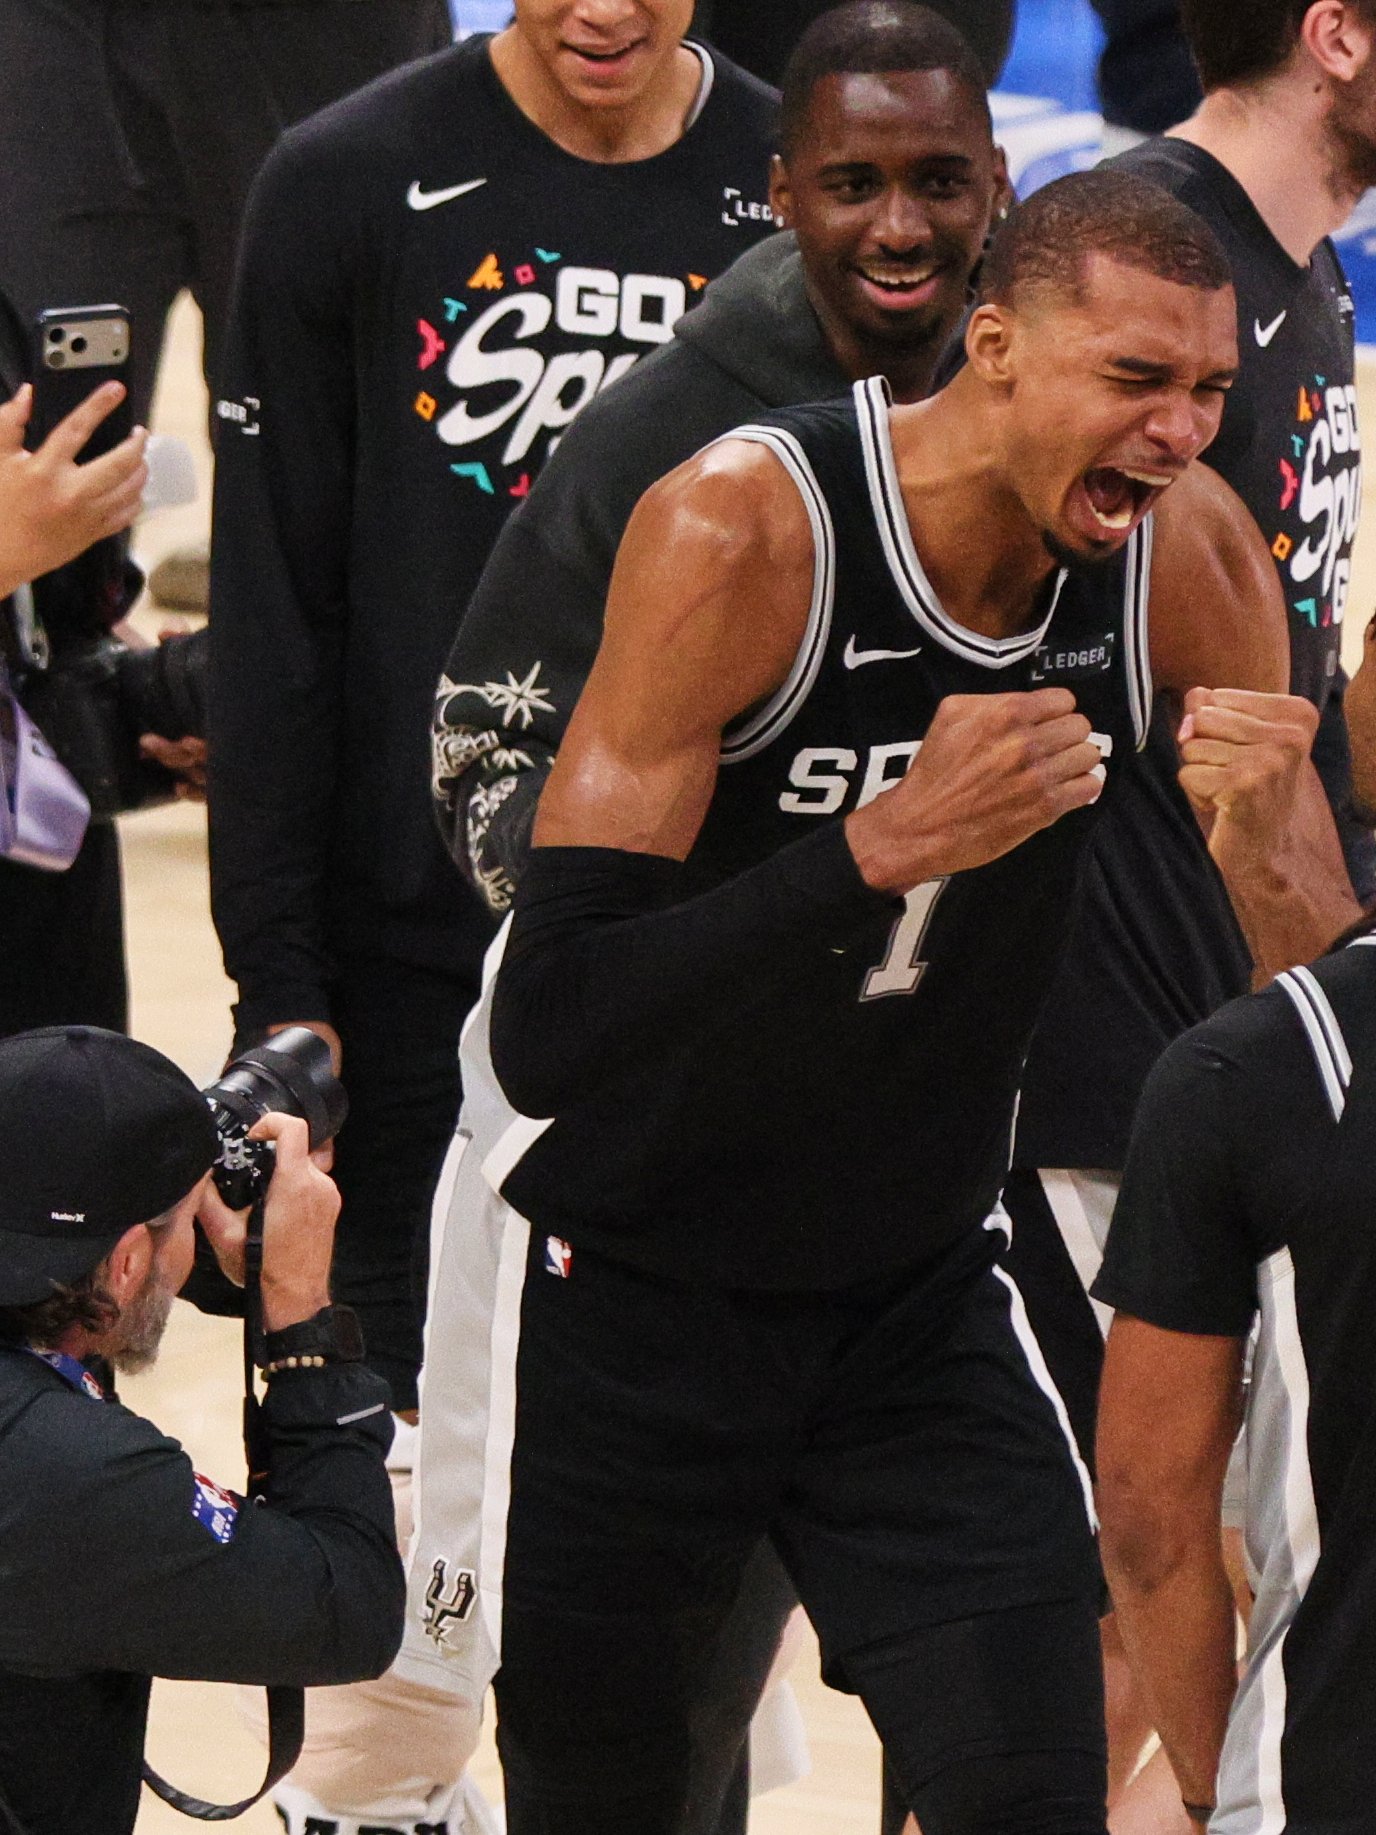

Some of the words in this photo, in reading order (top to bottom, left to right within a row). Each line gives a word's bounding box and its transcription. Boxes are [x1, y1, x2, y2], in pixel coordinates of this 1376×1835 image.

[735, 199, 784, 228] LED
[555, 265, 687, 344] GO
[436, 291, 640, 466] Sp
[1043, 646, 1106, 670] LEDGER
[858, 874, 951, 1002] 1
